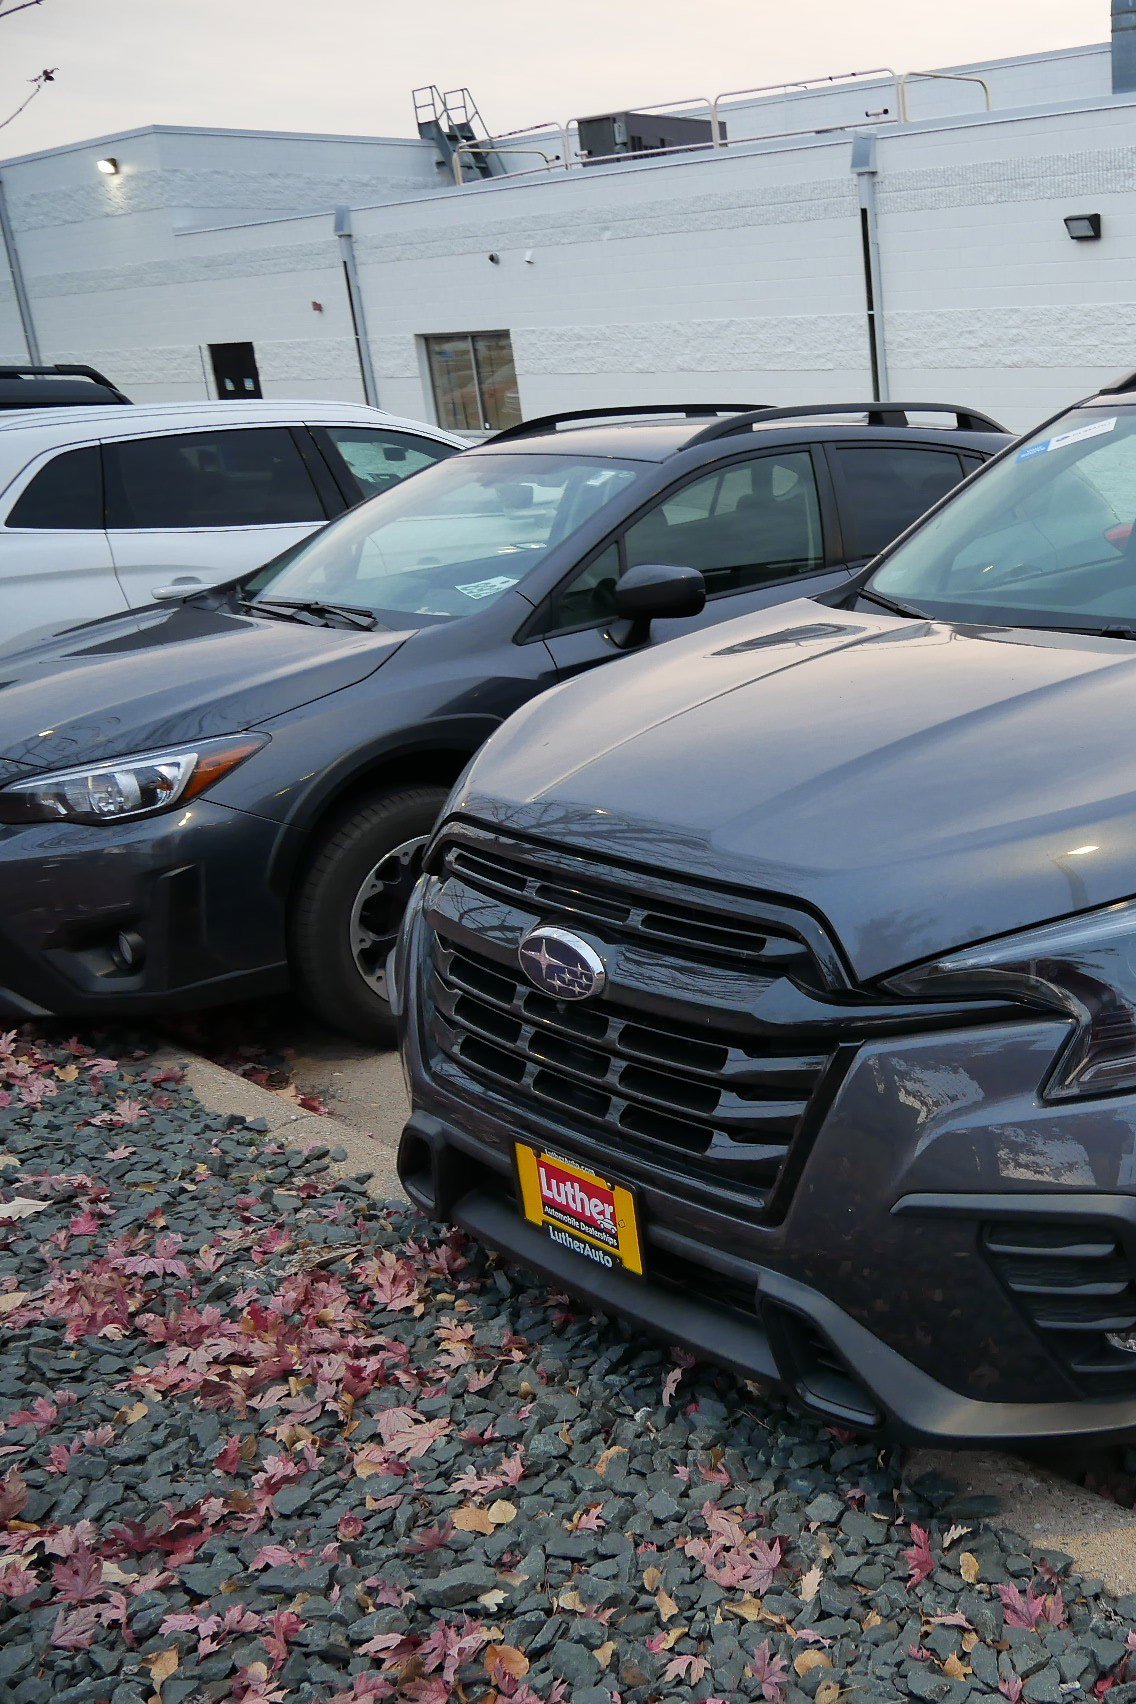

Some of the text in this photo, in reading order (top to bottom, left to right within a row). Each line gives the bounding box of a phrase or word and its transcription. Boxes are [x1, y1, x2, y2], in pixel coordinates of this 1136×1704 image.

[539, 1167, 614, 1220] Luther
[544, 1205, 618, 1246] Automobile Dealerships
[548, 1225, 613, 1268] LutherAuto
